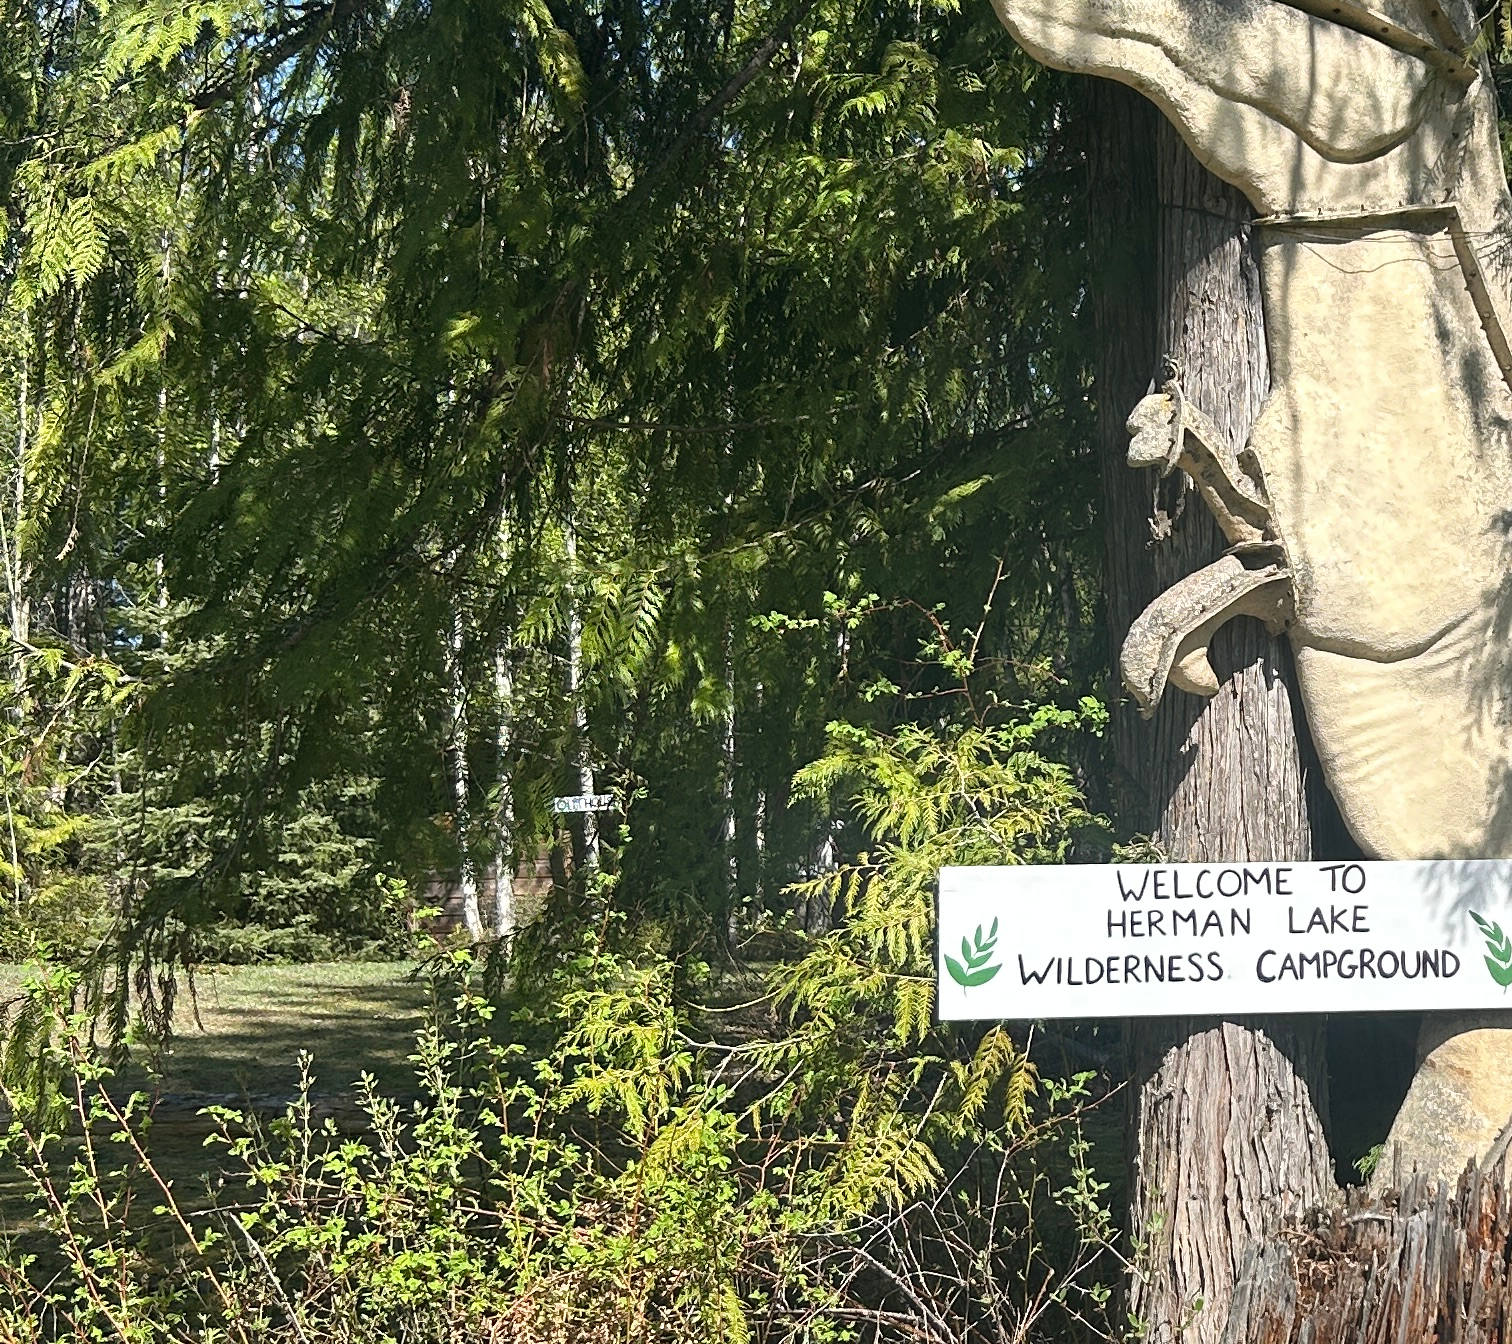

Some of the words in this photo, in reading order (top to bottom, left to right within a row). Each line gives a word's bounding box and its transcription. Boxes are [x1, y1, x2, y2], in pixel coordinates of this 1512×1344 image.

[1116, 867, 1294, 902] WELCOME
[1319, 863, 1367, 894] TO
[1107, 908, 1251, 938] HERMAN
[1288, 904, 1371, 935] LAKE
[1017, 951, 1225, 986] WILDERNESS
[1256, 948, 1461, 984] CAMPGROUND
